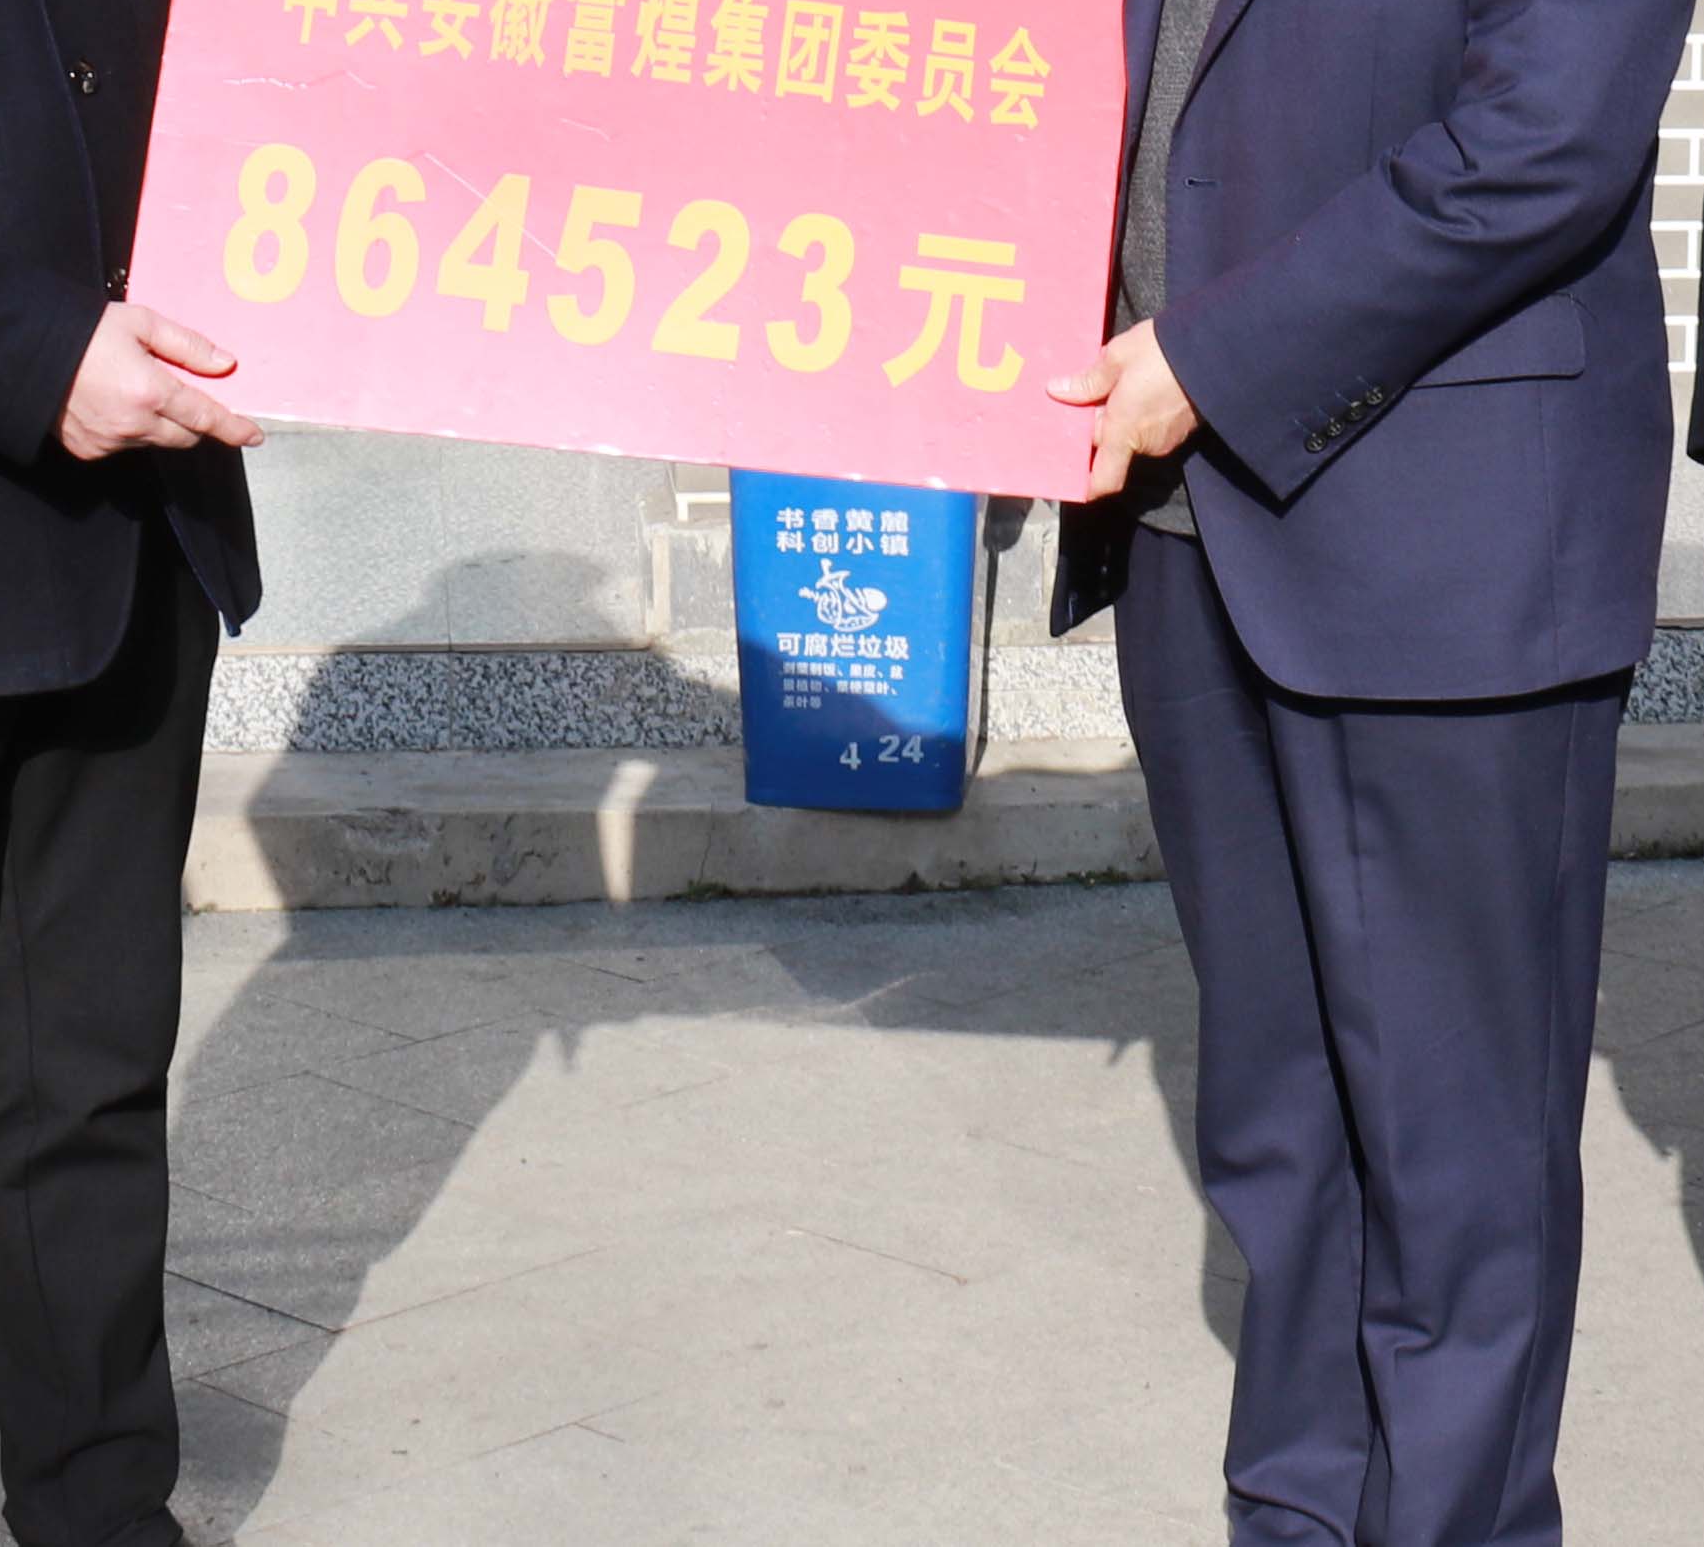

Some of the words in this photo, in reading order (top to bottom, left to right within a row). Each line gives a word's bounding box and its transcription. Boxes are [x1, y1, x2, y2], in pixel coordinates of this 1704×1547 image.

[223, 144, 1025, 393] 864523元
[776, 507, 909, 533] 书香黄麓
[776, 531, 909, 556] 科创小镇
[776, 632, 909, 660] 可腐烂垃圾
[840, 742, 861, 770] 4
[878, 734, 925, 763] 24
